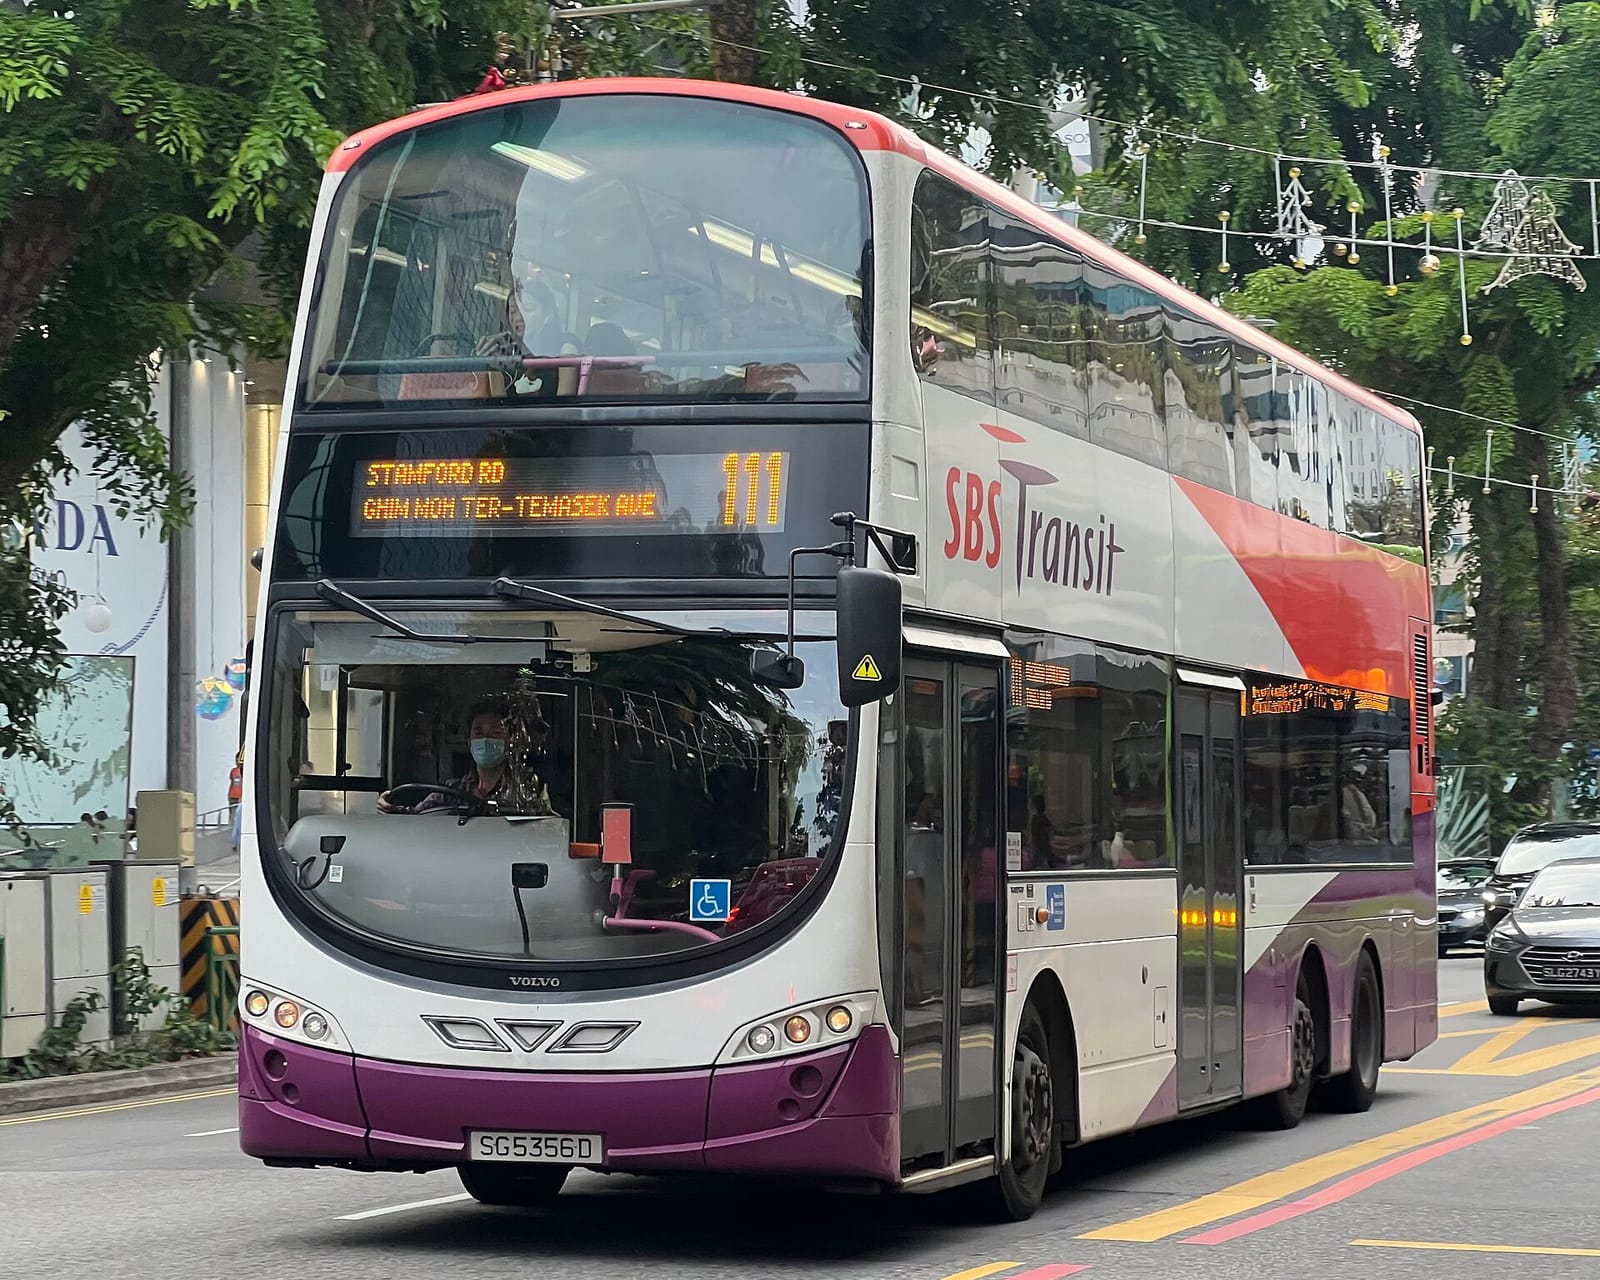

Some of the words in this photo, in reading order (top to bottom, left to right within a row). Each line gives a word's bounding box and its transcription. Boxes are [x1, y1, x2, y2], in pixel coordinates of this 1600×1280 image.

[366, 462, 474, 486] STAMFORD
[478, 461, 505, 484] RD
[723, 452, 782, 525] 111
[363, 497, 410, 520] GHIM
[414, 497, 456, 519] MOH
[461, 494, 611, 519] TER-TEMASEK
[615, 493, 656, 517] AVE
[944, 466, 1001, 569] SBS
[998, 459, 1125, 598] Transit
[509, 976, 560, 987] VOLVO
[480, 1135, 592, 1159] SG5356D
